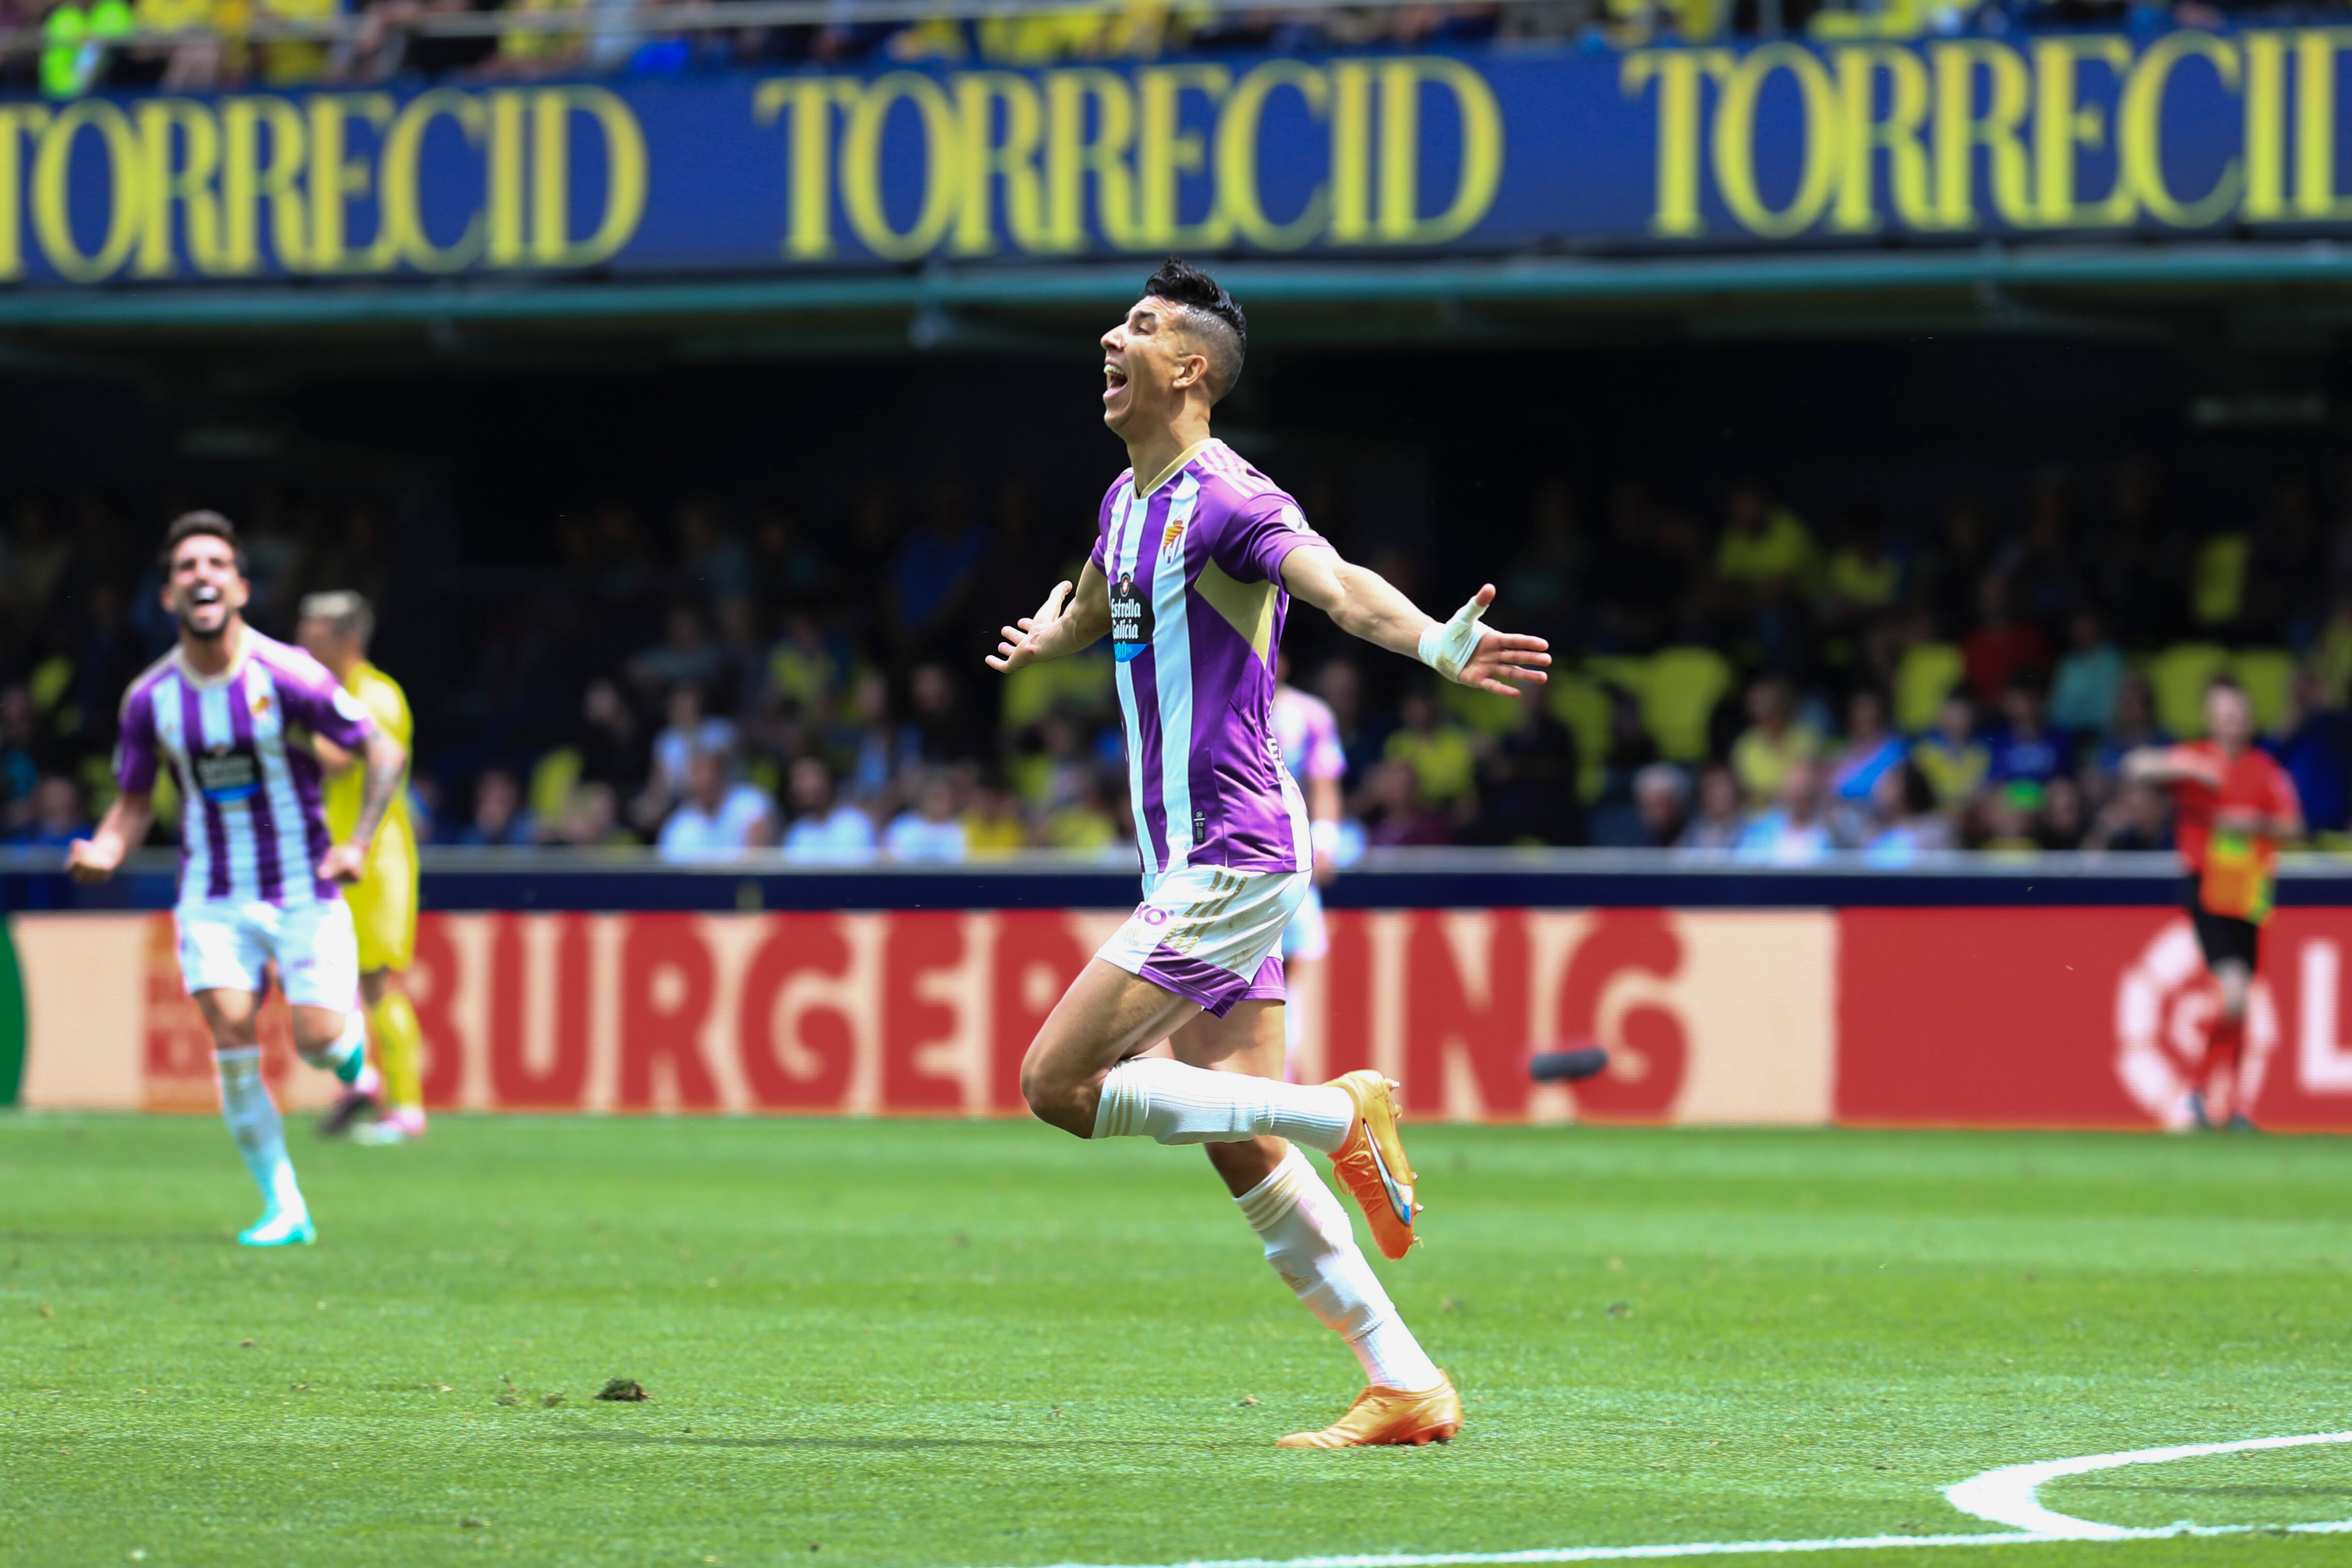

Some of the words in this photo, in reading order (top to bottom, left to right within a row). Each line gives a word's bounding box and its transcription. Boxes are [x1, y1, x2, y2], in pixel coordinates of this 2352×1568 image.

[753, 55, 1505, 262] TORRECID
[1111, 599, 1141, 618] Estrella
[1113, 619, 1139, 639] Galicia
